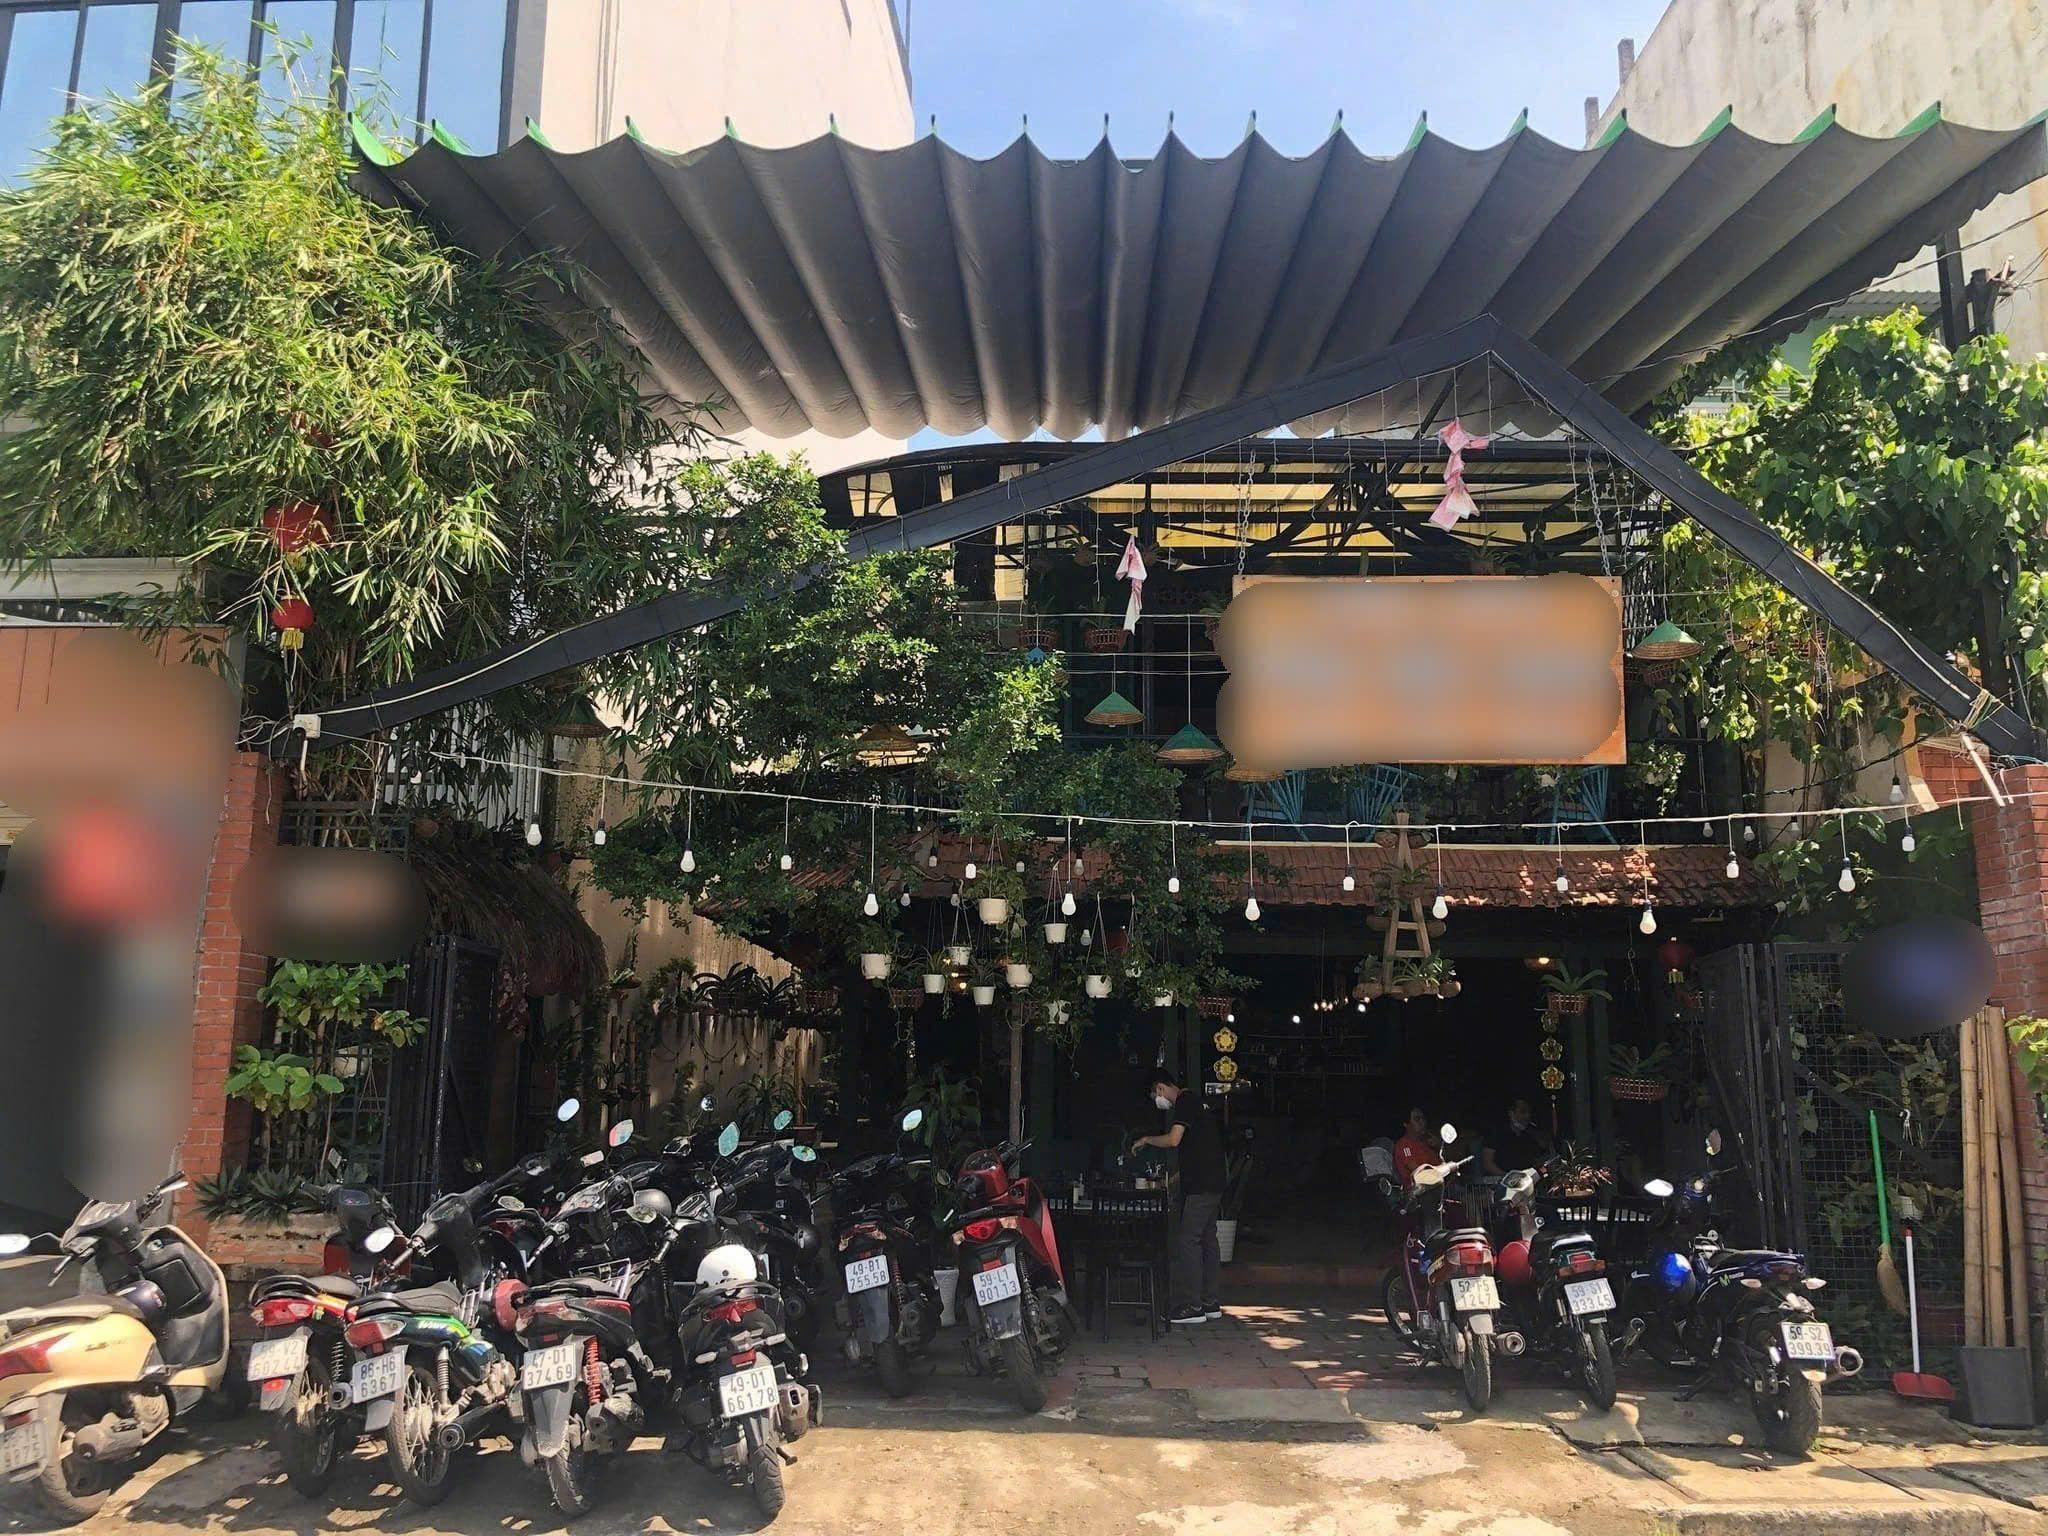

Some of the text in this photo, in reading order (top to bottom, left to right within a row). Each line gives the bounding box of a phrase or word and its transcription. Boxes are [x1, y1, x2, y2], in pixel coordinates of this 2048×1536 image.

[852, 1258, 881, 1276] 49-B1
[979, 1268, 1009, 1288] 59-L1
[1789, 1326, 1824, 1341] 59-S2
[360, 1372, 396, 1398] 6367
